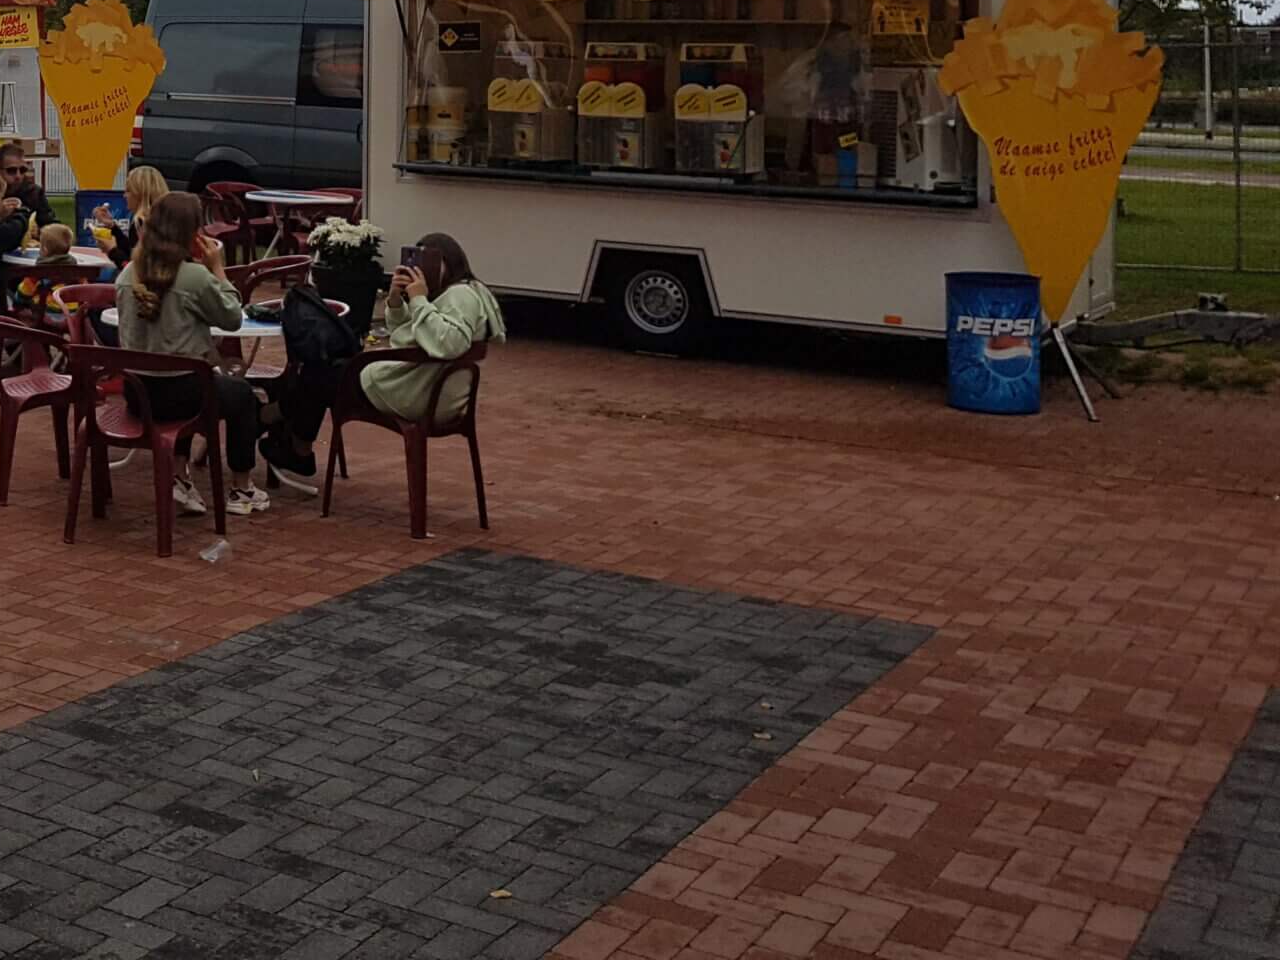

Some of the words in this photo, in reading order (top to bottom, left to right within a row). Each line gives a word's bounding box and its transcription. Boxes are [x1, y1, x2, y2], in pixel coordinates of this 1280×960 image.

[994, 136, 1061, 157] Vlaamse
[1000, 160, 1016, 176] de
[1024, 162, 1065, 181] enige
[956, 315, 1036, 337] PEPSI
